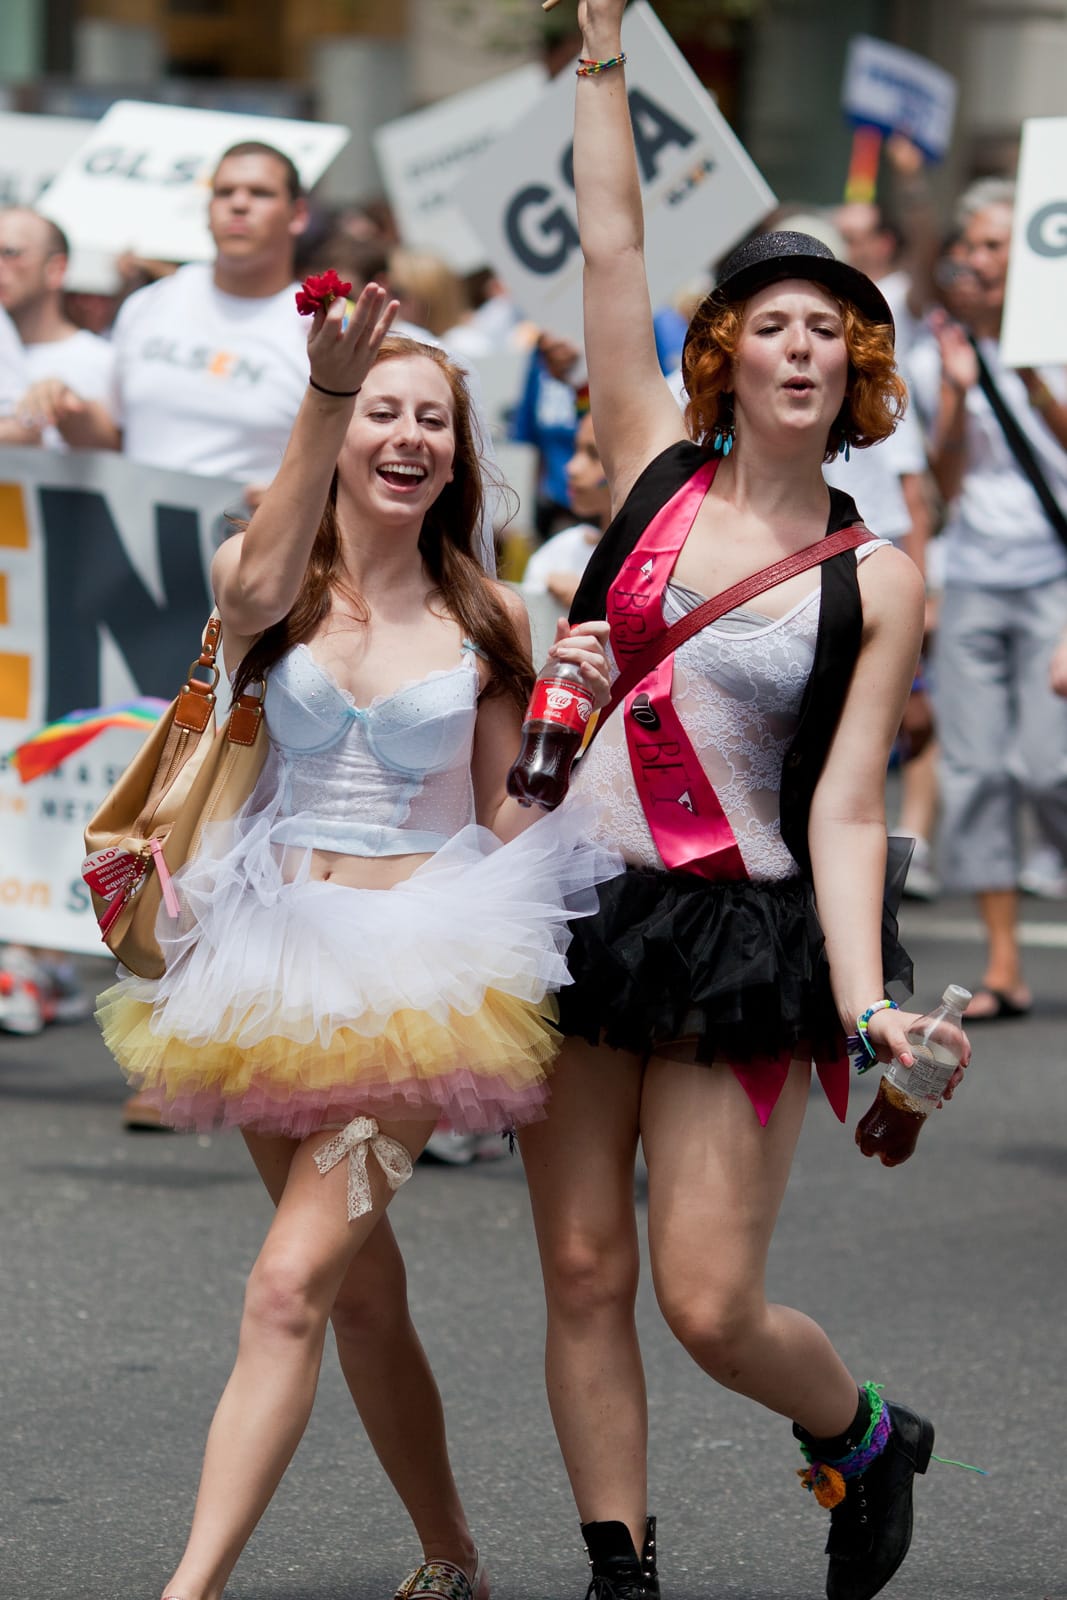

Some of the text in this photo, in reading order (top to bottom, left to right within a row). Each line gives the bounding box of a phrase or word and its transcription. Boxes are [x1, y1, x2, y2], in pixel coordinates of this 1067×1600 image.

[84, 147, 214, 188] GLS
[505, 87, 696, 275] GA
[632, 695, 656, 723] TO
[635, 741, 692, 782] BE
[95, 858, 127, 876] support
[98, 863, 134, 885] marriage
